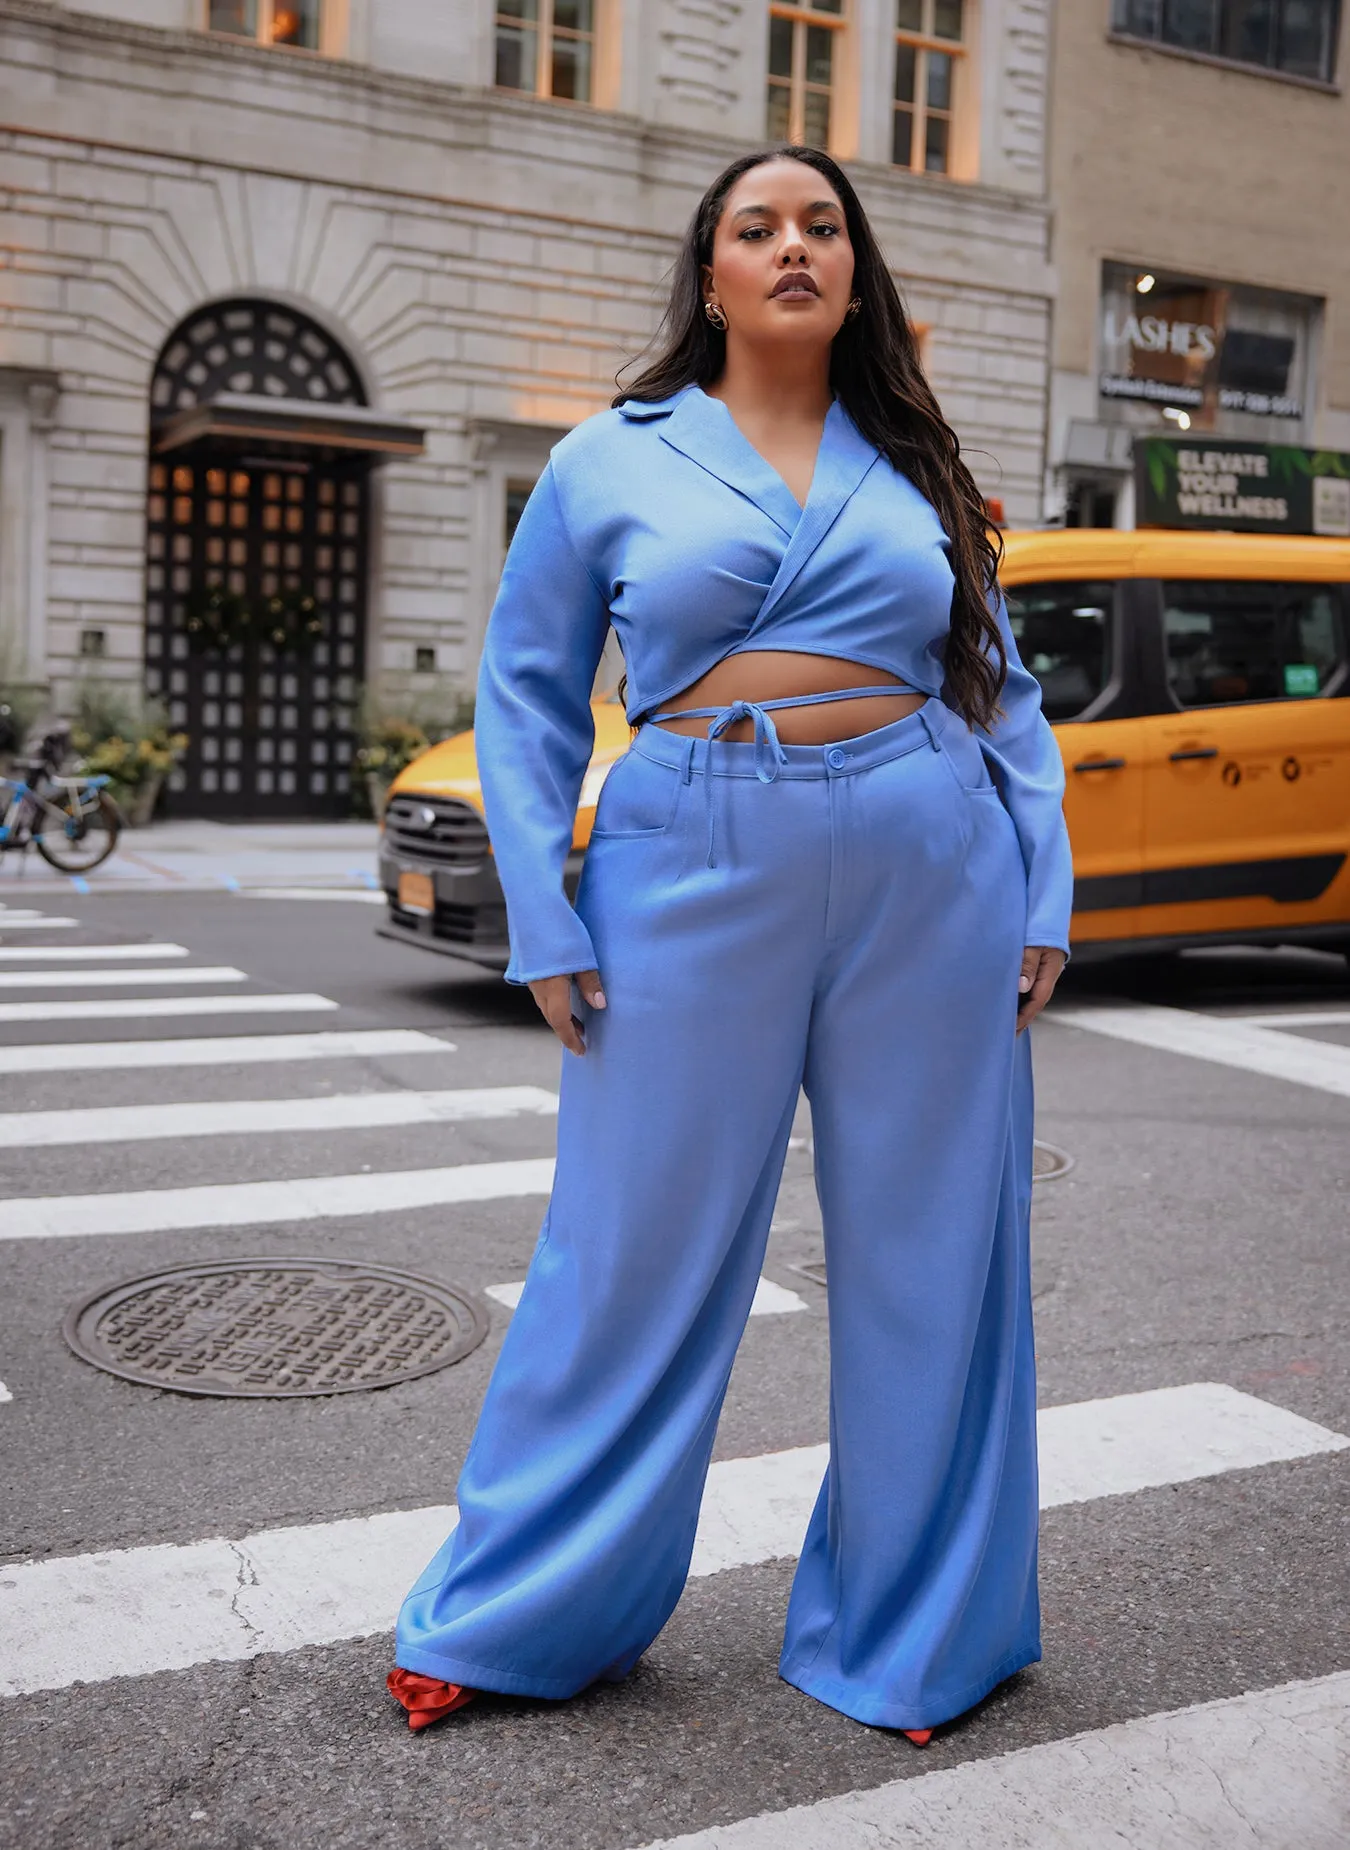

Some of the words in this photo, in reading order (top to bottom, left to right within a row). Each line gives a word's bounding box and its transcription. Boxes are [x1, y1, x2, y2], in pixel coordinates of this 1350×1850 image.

[1104, 309, 1216, 360] LASHES
[1177, 450, 1269, 477] ELEVATE
[1177, 473, 1238, 494] YOUR
[1177, 496, 1287, 520] WELLNESS
[211, 1320, 296, 1373] SEWER
